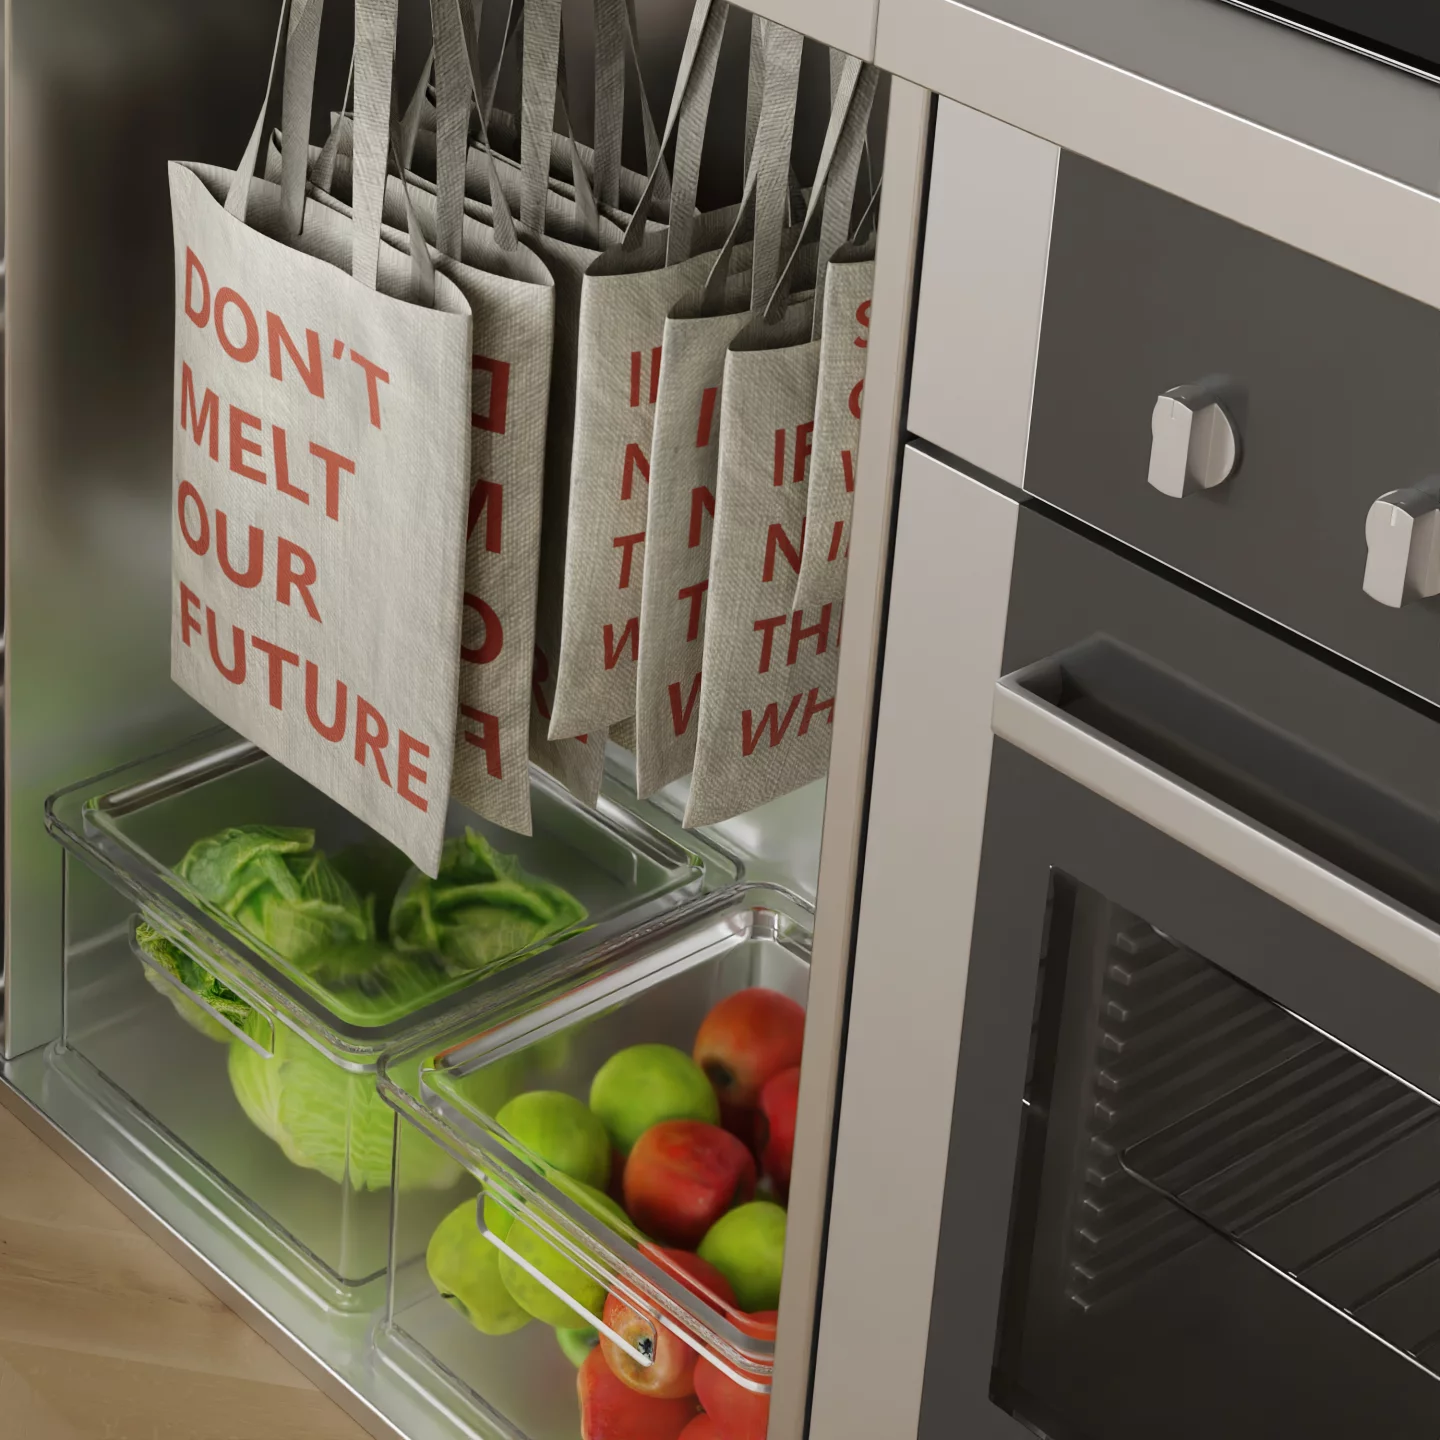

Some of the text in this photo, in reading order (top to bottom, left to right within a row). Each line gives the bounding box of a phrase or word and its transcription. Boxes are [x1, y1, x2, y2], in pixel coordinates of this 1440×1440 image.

[184, 245, 391, 432] DON'T
[180, 360, 357, 523] MELT
[177, 479, 323, 625] OUR
[178, 580, 431, 814] FUTURE
[753, 601, 844, 675] TH
